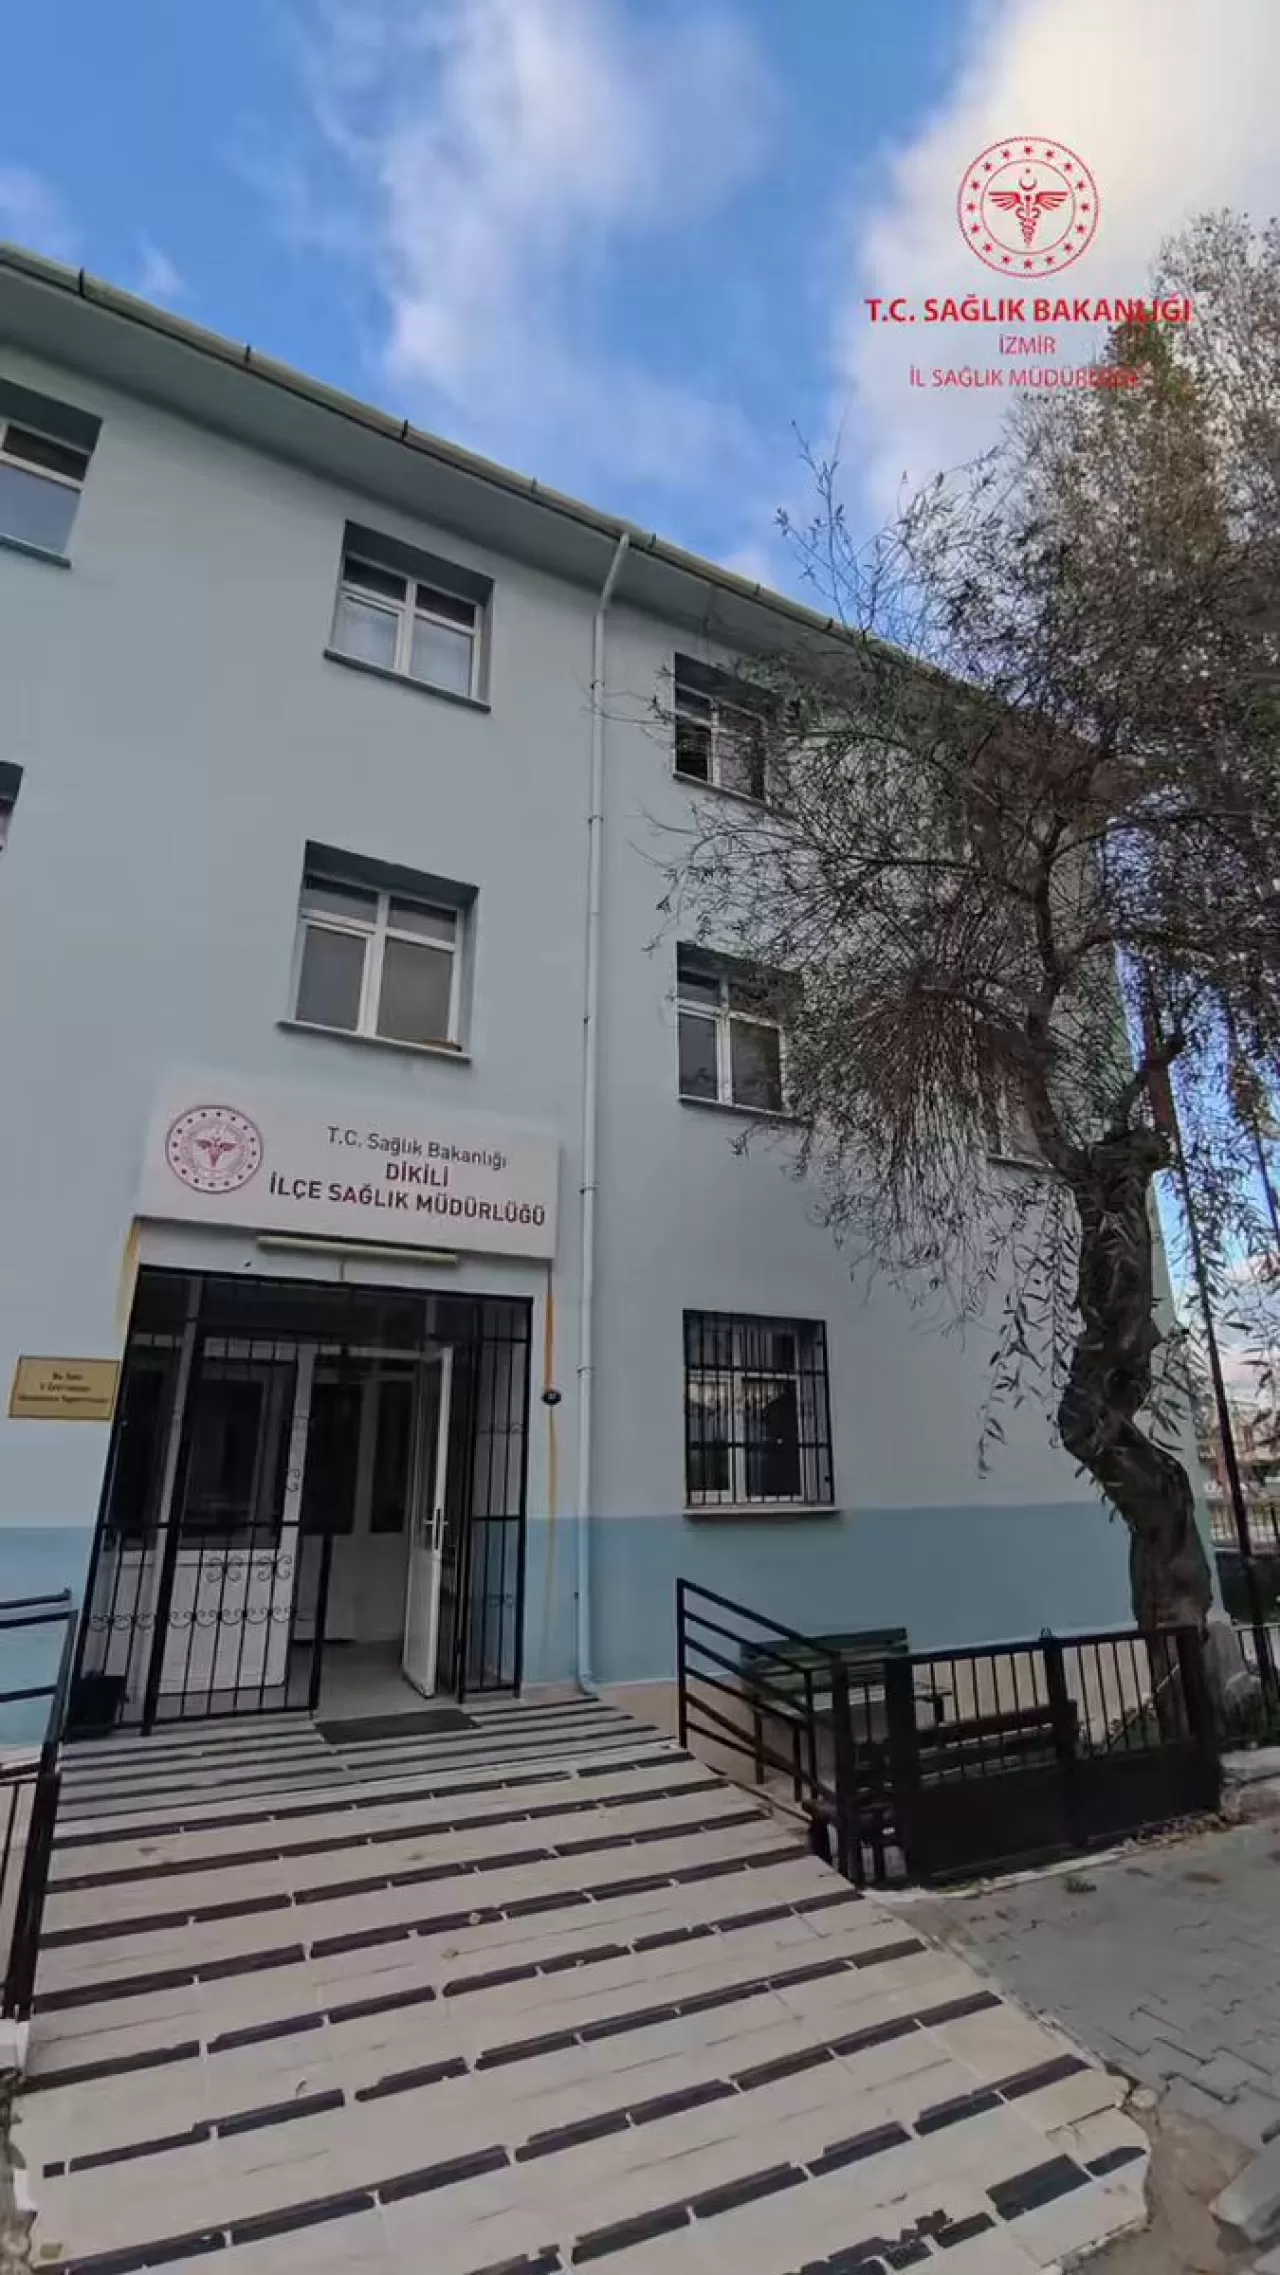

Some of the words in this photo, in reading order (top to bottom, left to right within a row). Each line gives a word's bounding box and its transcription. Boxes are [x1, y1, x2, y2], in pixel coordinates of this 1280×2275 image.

[327, 1126, 363, 1148] T.C.
[368, 1133, 422, 1158] Sağlık
[428, 1143, 507, 1170] Bakanlığı
[386, 1162, 449, 1188] DİKİLİ
[270, 1172, 321, 1201] İLÇE
[329, 1182, 408, 1211] SAĞLIK
[416, 1194, 546, 1227] MÜDÜRLÜĞÜ
